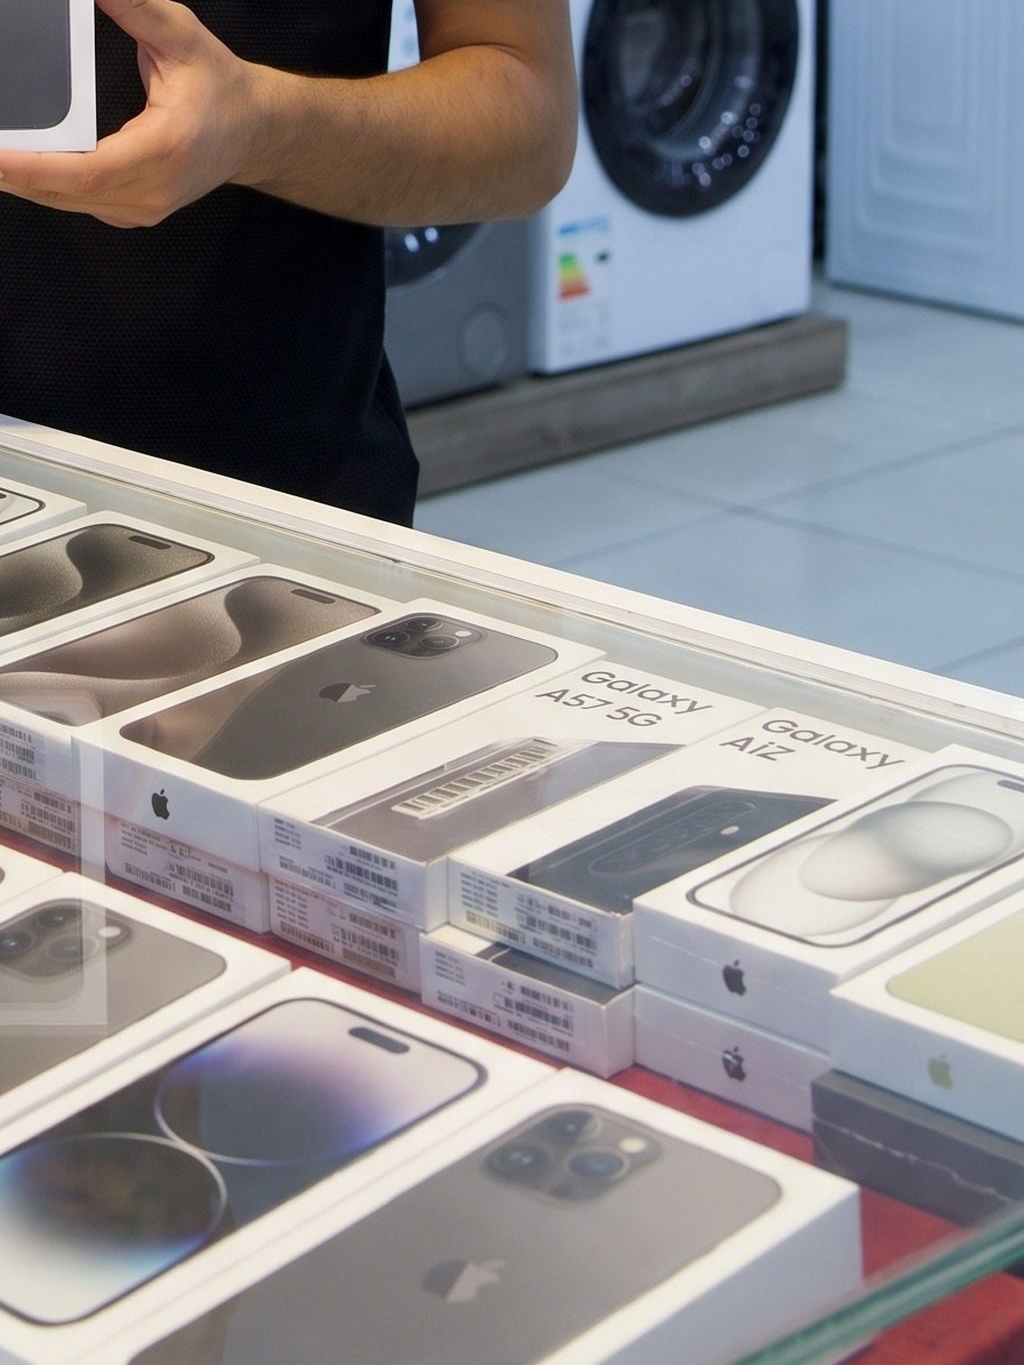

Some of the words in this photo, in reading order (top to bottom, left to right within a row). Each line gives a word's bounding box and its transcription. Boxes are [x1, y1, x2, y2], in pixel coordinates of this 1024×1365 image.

[534, 688, 615, 710] A57
[605, 706, 663, 727] 5G
[580, 670, 714, 715] Galaxy
[761, 719, 906, 770] Galaxy
